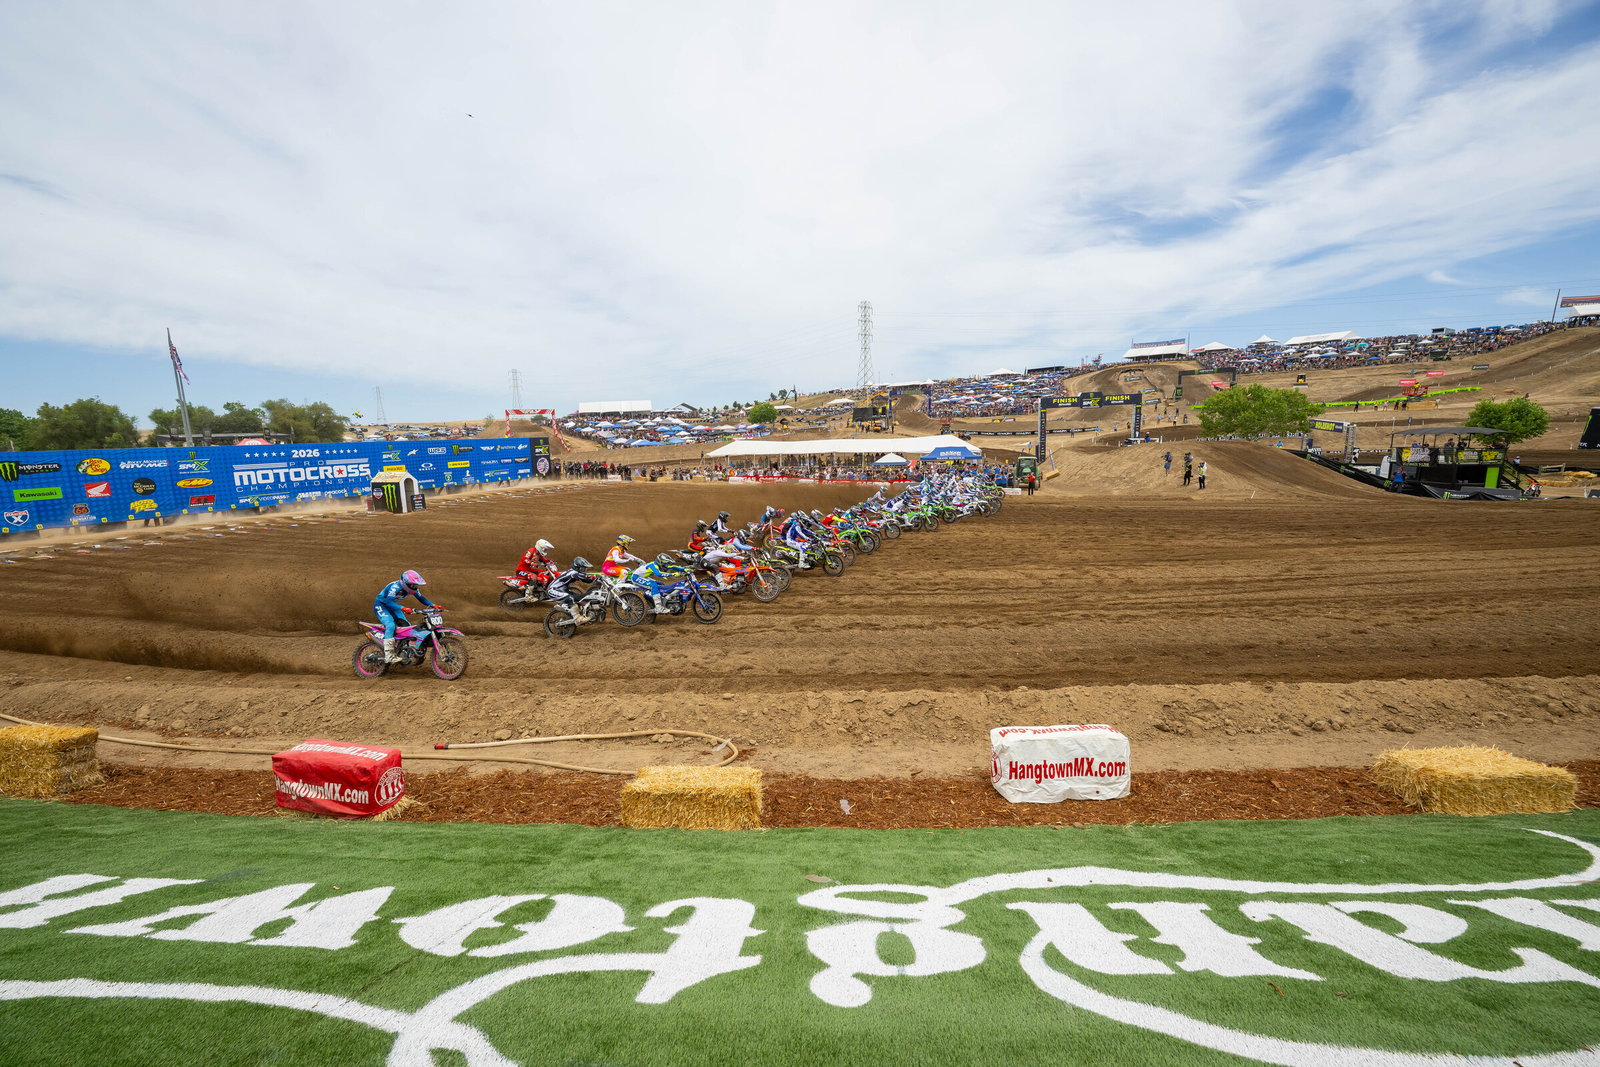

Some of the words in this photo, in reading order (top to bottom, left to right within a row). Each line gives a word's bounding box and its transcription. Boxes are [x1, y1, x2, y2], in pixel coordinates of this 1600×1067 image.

[291, 448, 320, 458] 2026
[18, 463, 59, 471] MONSTER
[178, 460, 209, 471] SMX
[233, 464, 371, 486] MOTOCROSS
[19, 490, 57, 498] Kawasaki
[375, 606, 389, 617] FLY
[431, 615, 443, 626] 800
[1008, 757, 1126, 784] HangtownMX.com
[276, 774, 369, 804] HangtownMX.com
